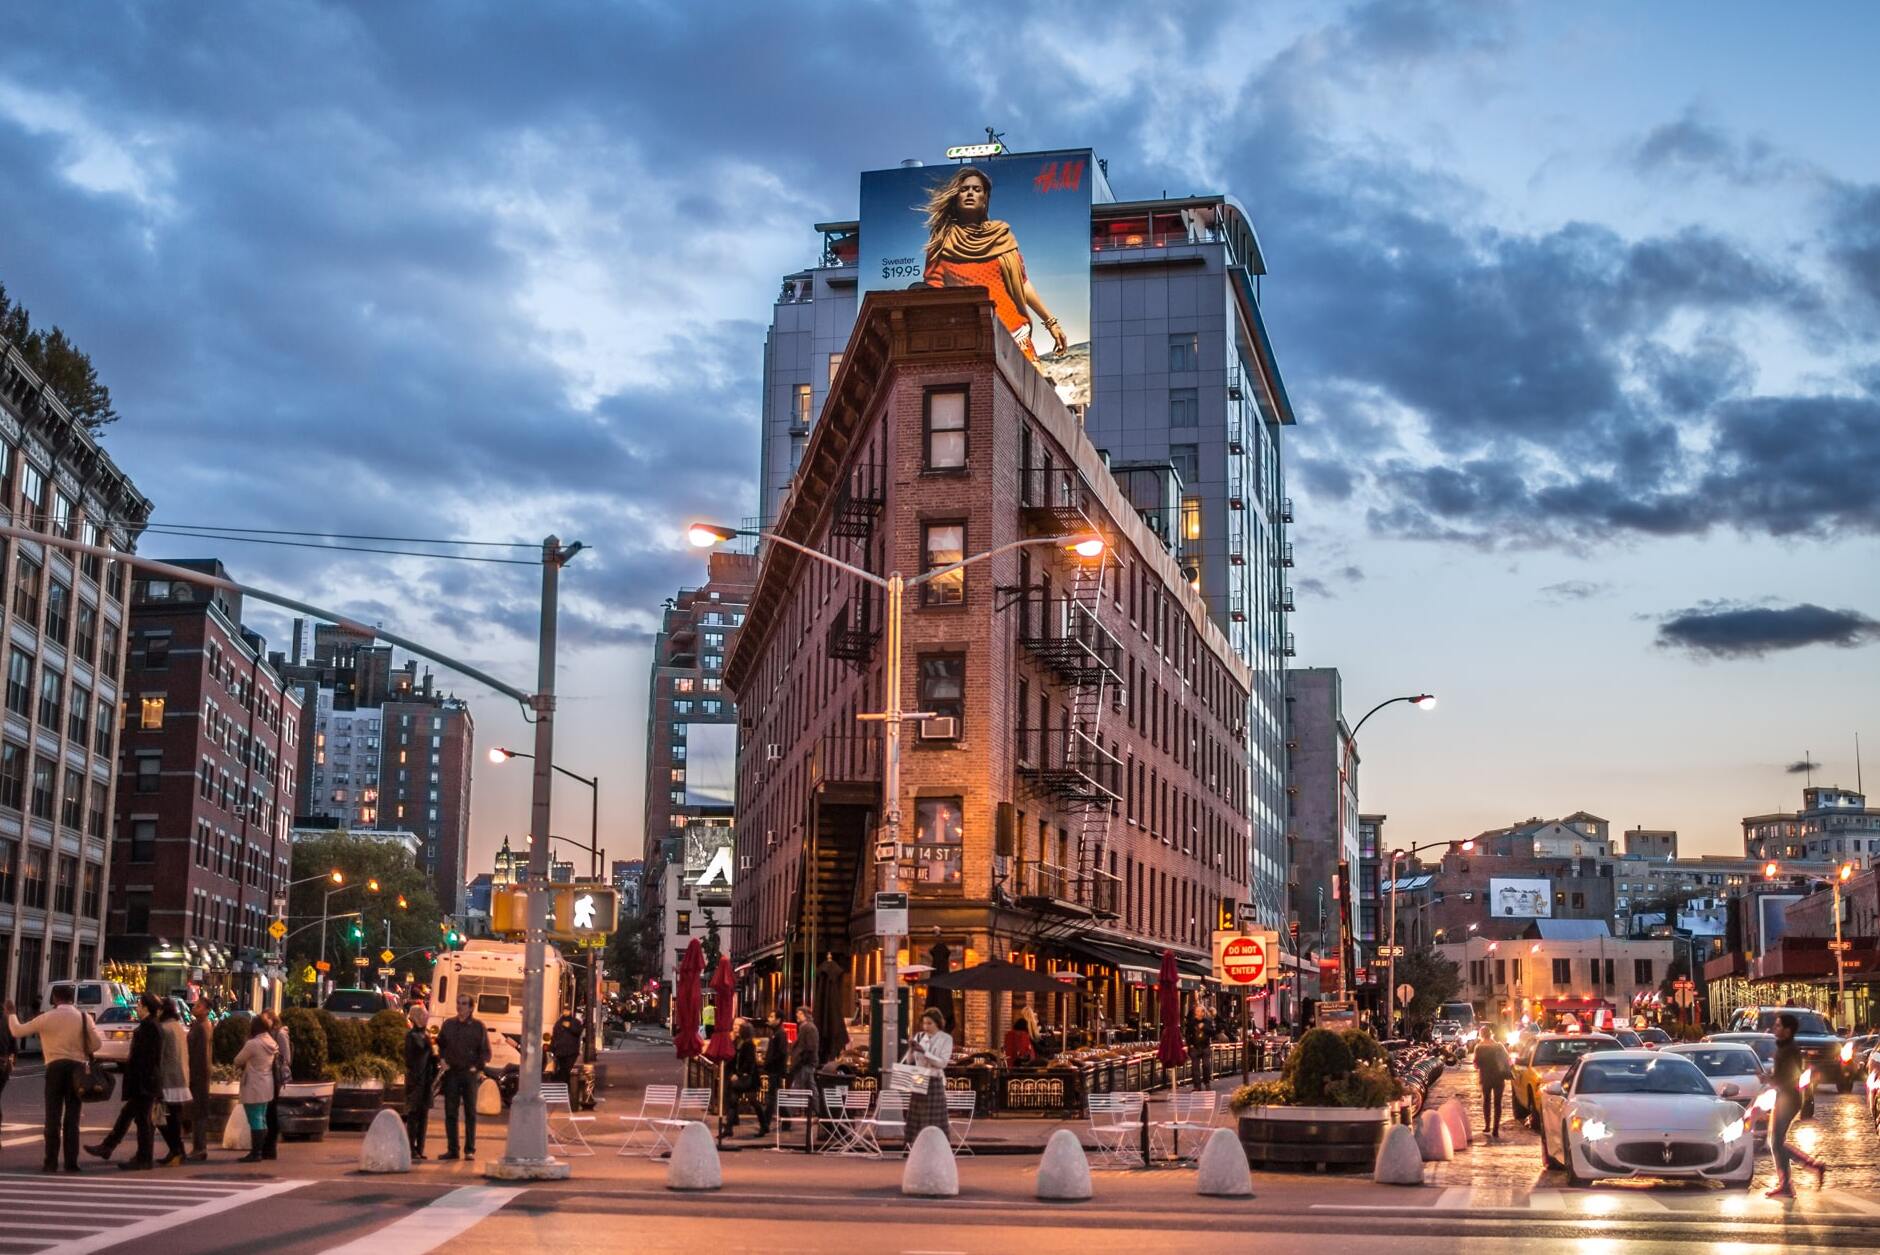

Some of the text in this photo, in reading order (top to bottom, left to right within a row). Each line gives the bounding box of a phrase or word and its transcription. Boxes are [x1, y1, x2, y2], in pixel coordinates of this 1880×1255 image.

[1033, 160, 1084, 193] H&M
[882, 257, 915, 266] Sweater
[882, 265, 921, 279] $19.95
[906, 847, 914, 858] W
[919, 847, 931, 860] 14
[936, 848, 950, 860] ST
[899, 867, 928, 880] NINTH AVE
[1229, 946, 1257, 954] DO NOT
[1231, 966, 1256, 975] ENTER
